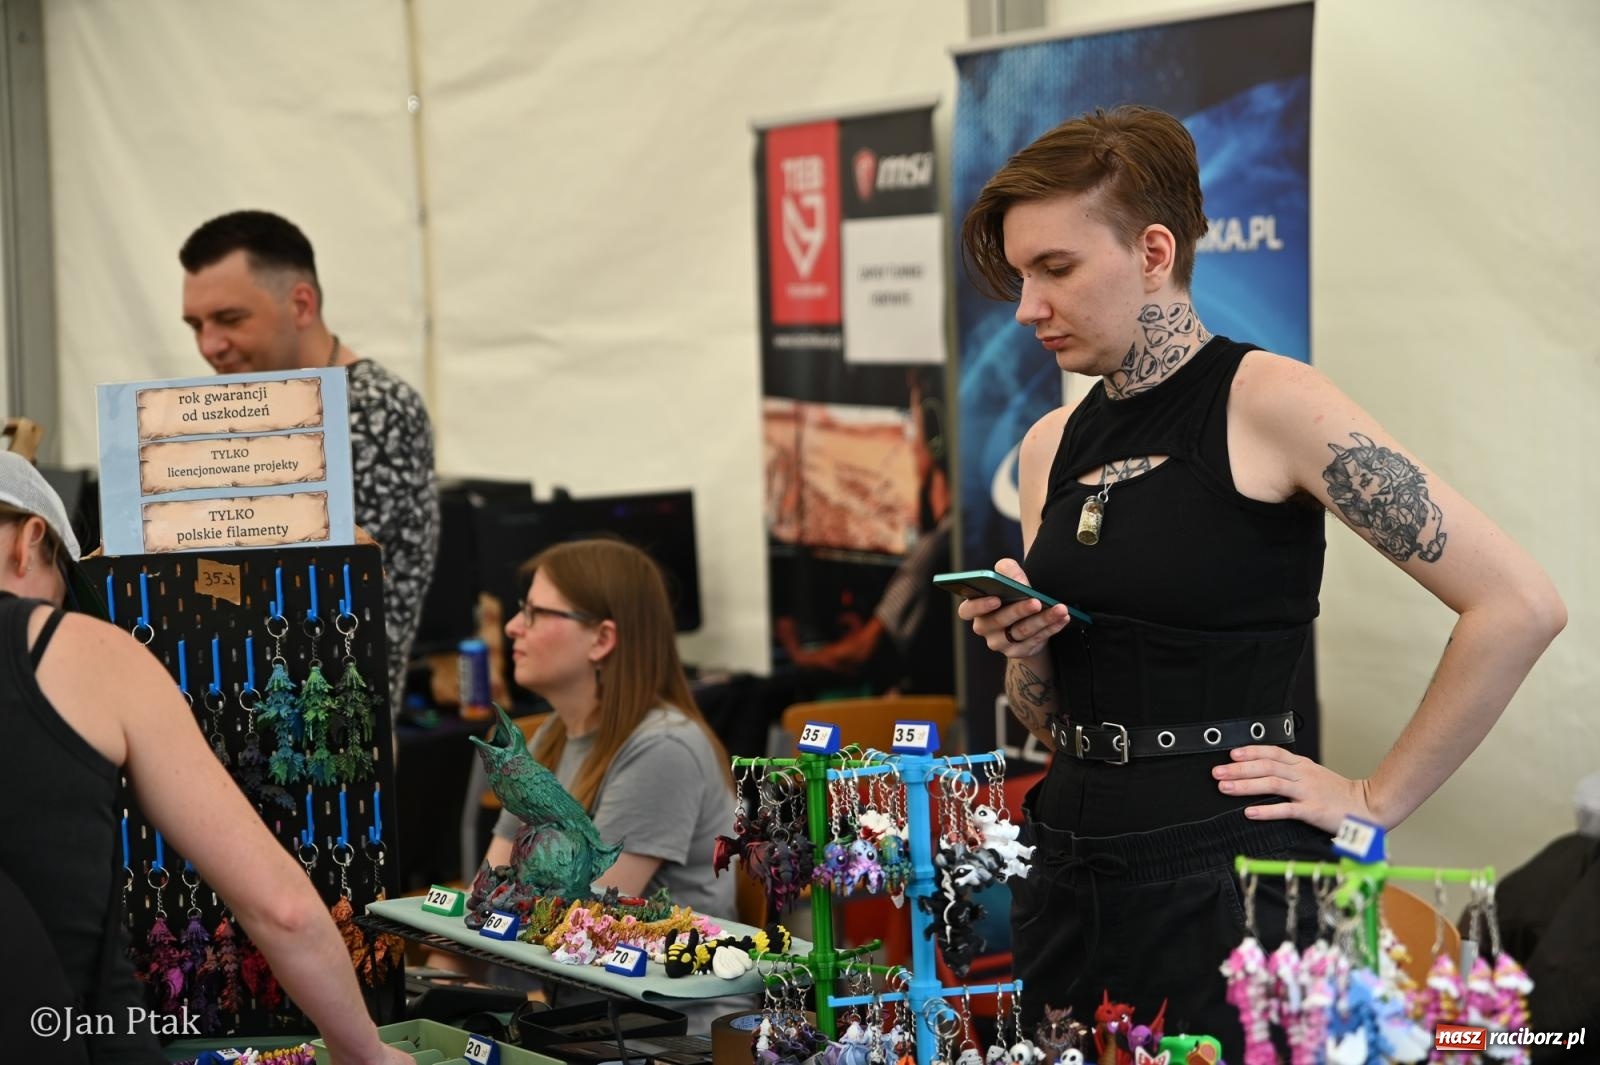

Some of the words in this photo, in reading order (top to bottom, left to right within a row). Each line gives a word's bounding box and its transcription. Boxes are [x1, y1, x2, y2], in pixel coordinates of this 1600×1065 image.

[876, 152, 933, 189] msi
[178, 391, 201, 405] rok
[204, 387, 268, 406] gwarancji
[182, 407, 198, 422] od
[202, 404, 270, 421] uszkodzeń
[211, 448, 249, 460] TYLKO
[167, 464, 250, 479] licencjonowane
[253, 459, 299, 474] projekty
[208, 508, 255, 521] TYLKO
[176, 527, 223, 544] polskie
[226, 523, 289, 539] filamenty
[802, 728, 820, 742] 35
[895, 728, 915, 742] 35
[427, 890, 447, 905] 120
[486, 916, 502, 929] 60
[612, 950, 629, 964] 70
[466, 1041, 481, 1057] 20
